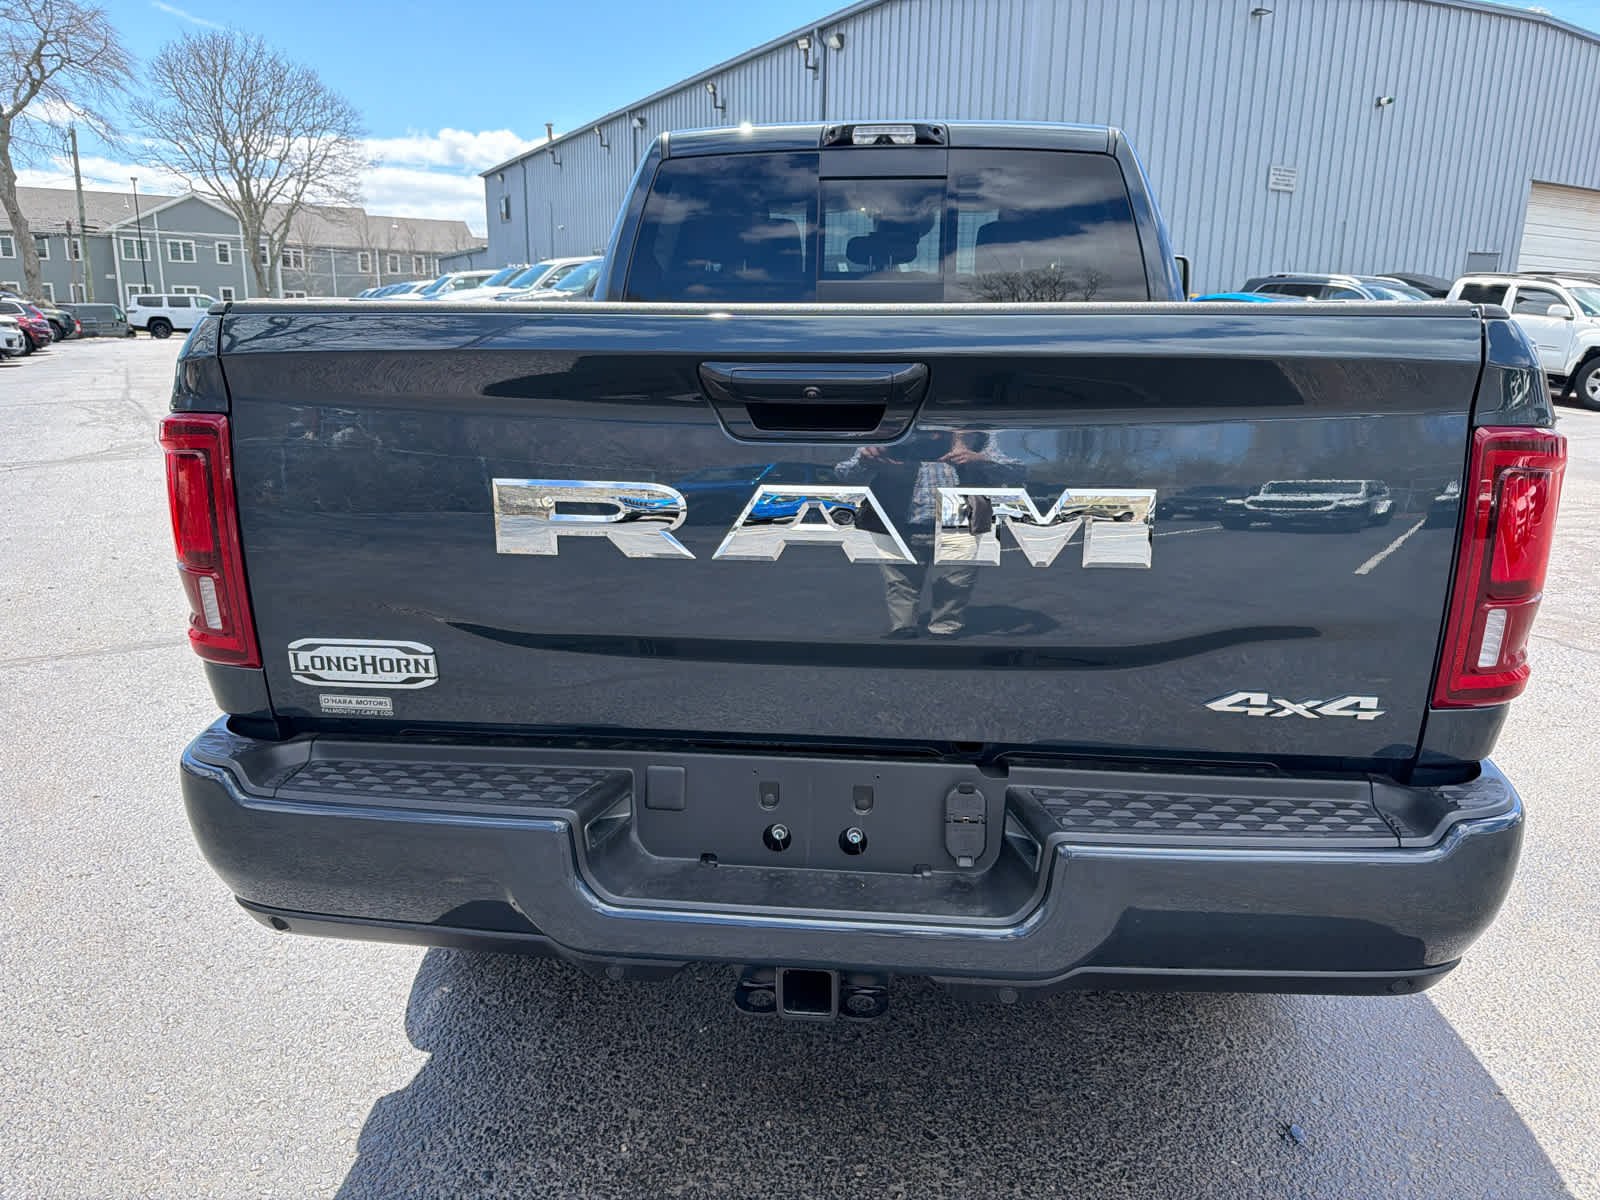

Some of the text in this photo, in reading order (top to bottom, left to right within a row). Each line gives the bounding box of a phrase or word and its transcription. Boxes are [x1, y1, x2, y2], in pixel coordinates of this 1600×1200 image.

[492, 478, 1158, 569] RAM
[292, 652, 432, 675] LONGHORN
[323, 697, 389, 707] O'HARA MOTORS
